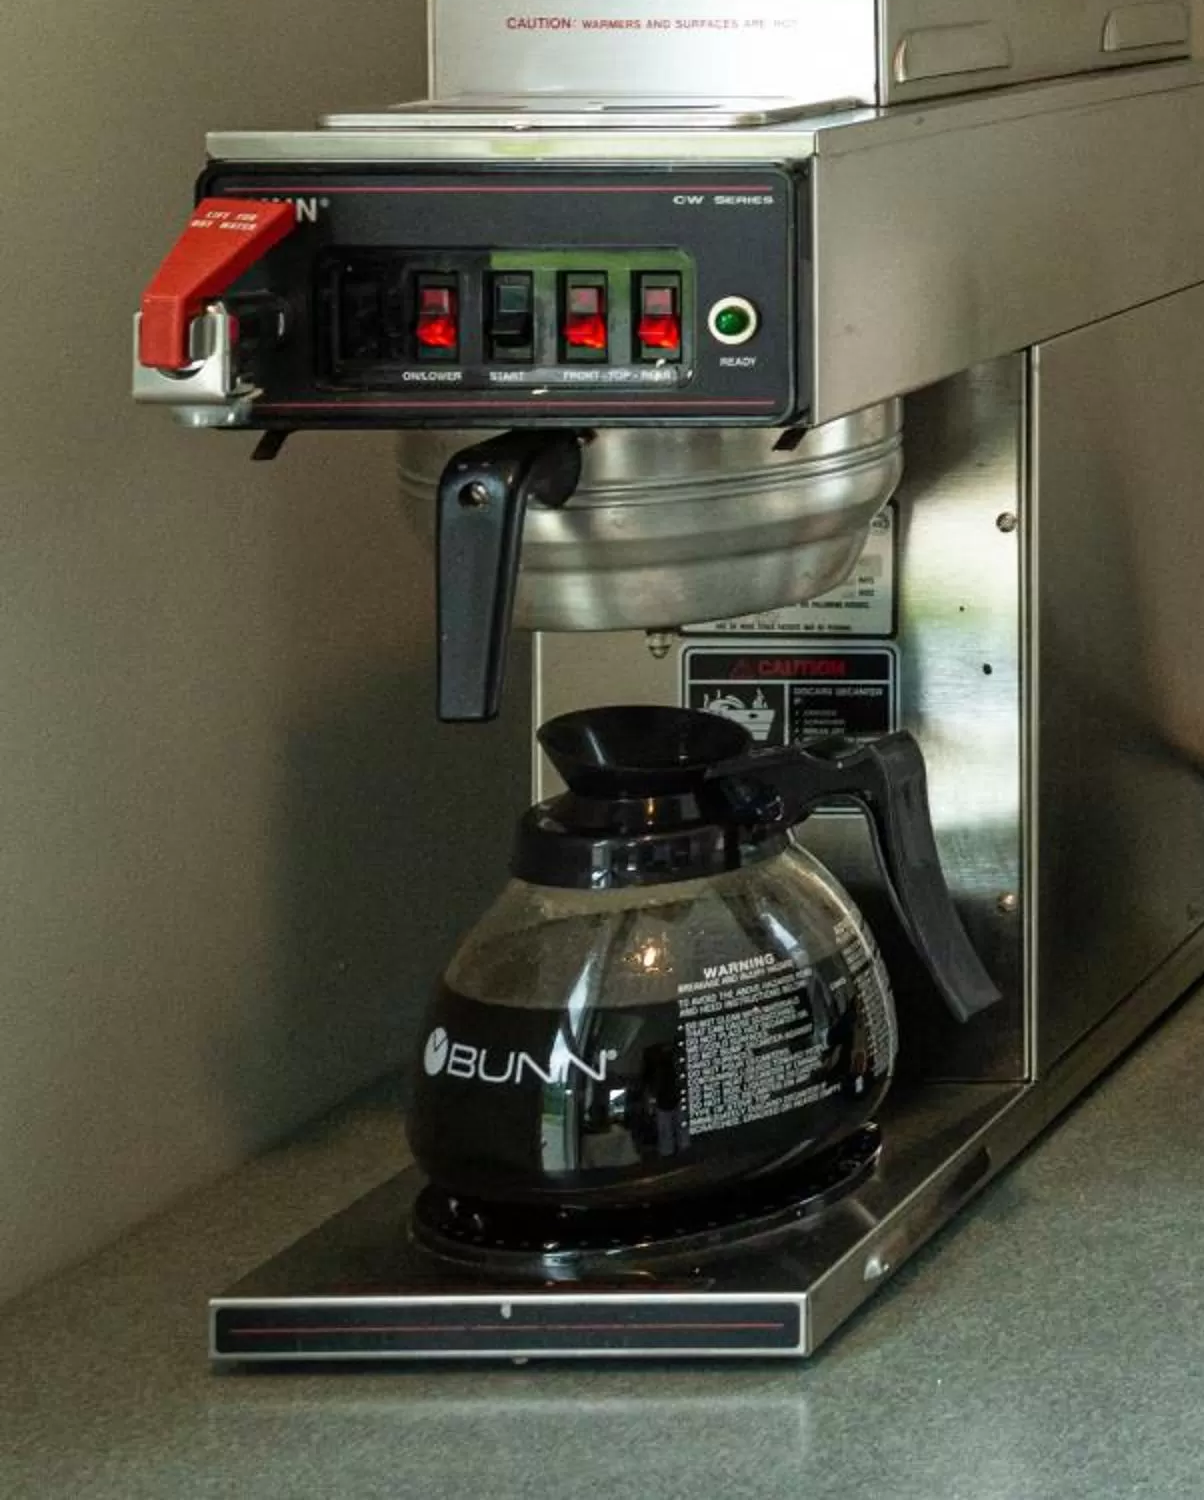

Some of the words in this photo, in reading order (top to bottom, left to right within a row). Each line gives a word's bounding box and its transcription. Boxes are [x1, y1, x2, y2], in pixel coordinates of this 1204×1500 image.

[506, 17, 575, 30] CAUTION:
[581, 19, 641, 29] WARMERS
[646, 19, 671, 29] AND
[675, 19, 739, 30] SURFACES
[672, 195, 705, 205] CW
[713, 195, 774, 205] SERIES
[719, 356, 756, 367] READY
[489, 371, 525, 382] START
[757, 660, 846, 677] CAUTION
[703, 953, 776, 979] WARNING
[447, 1046, 607, 1084] BUNN
